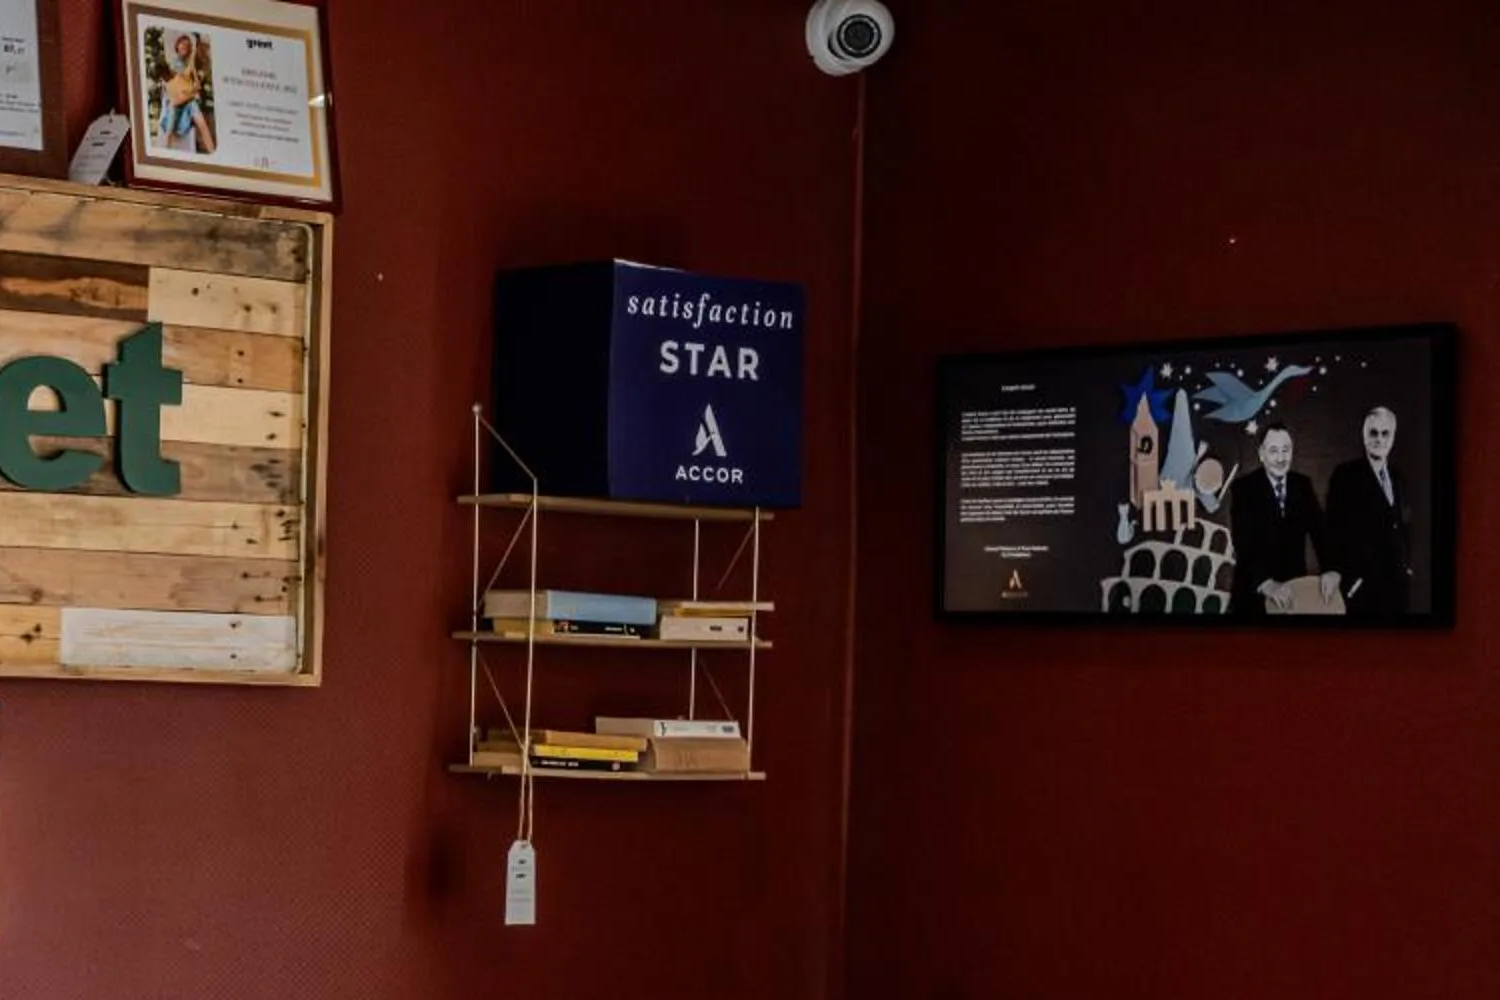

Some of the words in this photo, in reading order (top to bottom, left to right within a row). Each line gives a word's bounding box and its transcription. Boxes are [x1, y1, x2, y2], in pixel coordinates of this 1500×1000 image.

[626, 292, 794, 330] satisfaction
[659, 339, 760, 381] STAR
[674, 464, 744, 484] ACCOR
